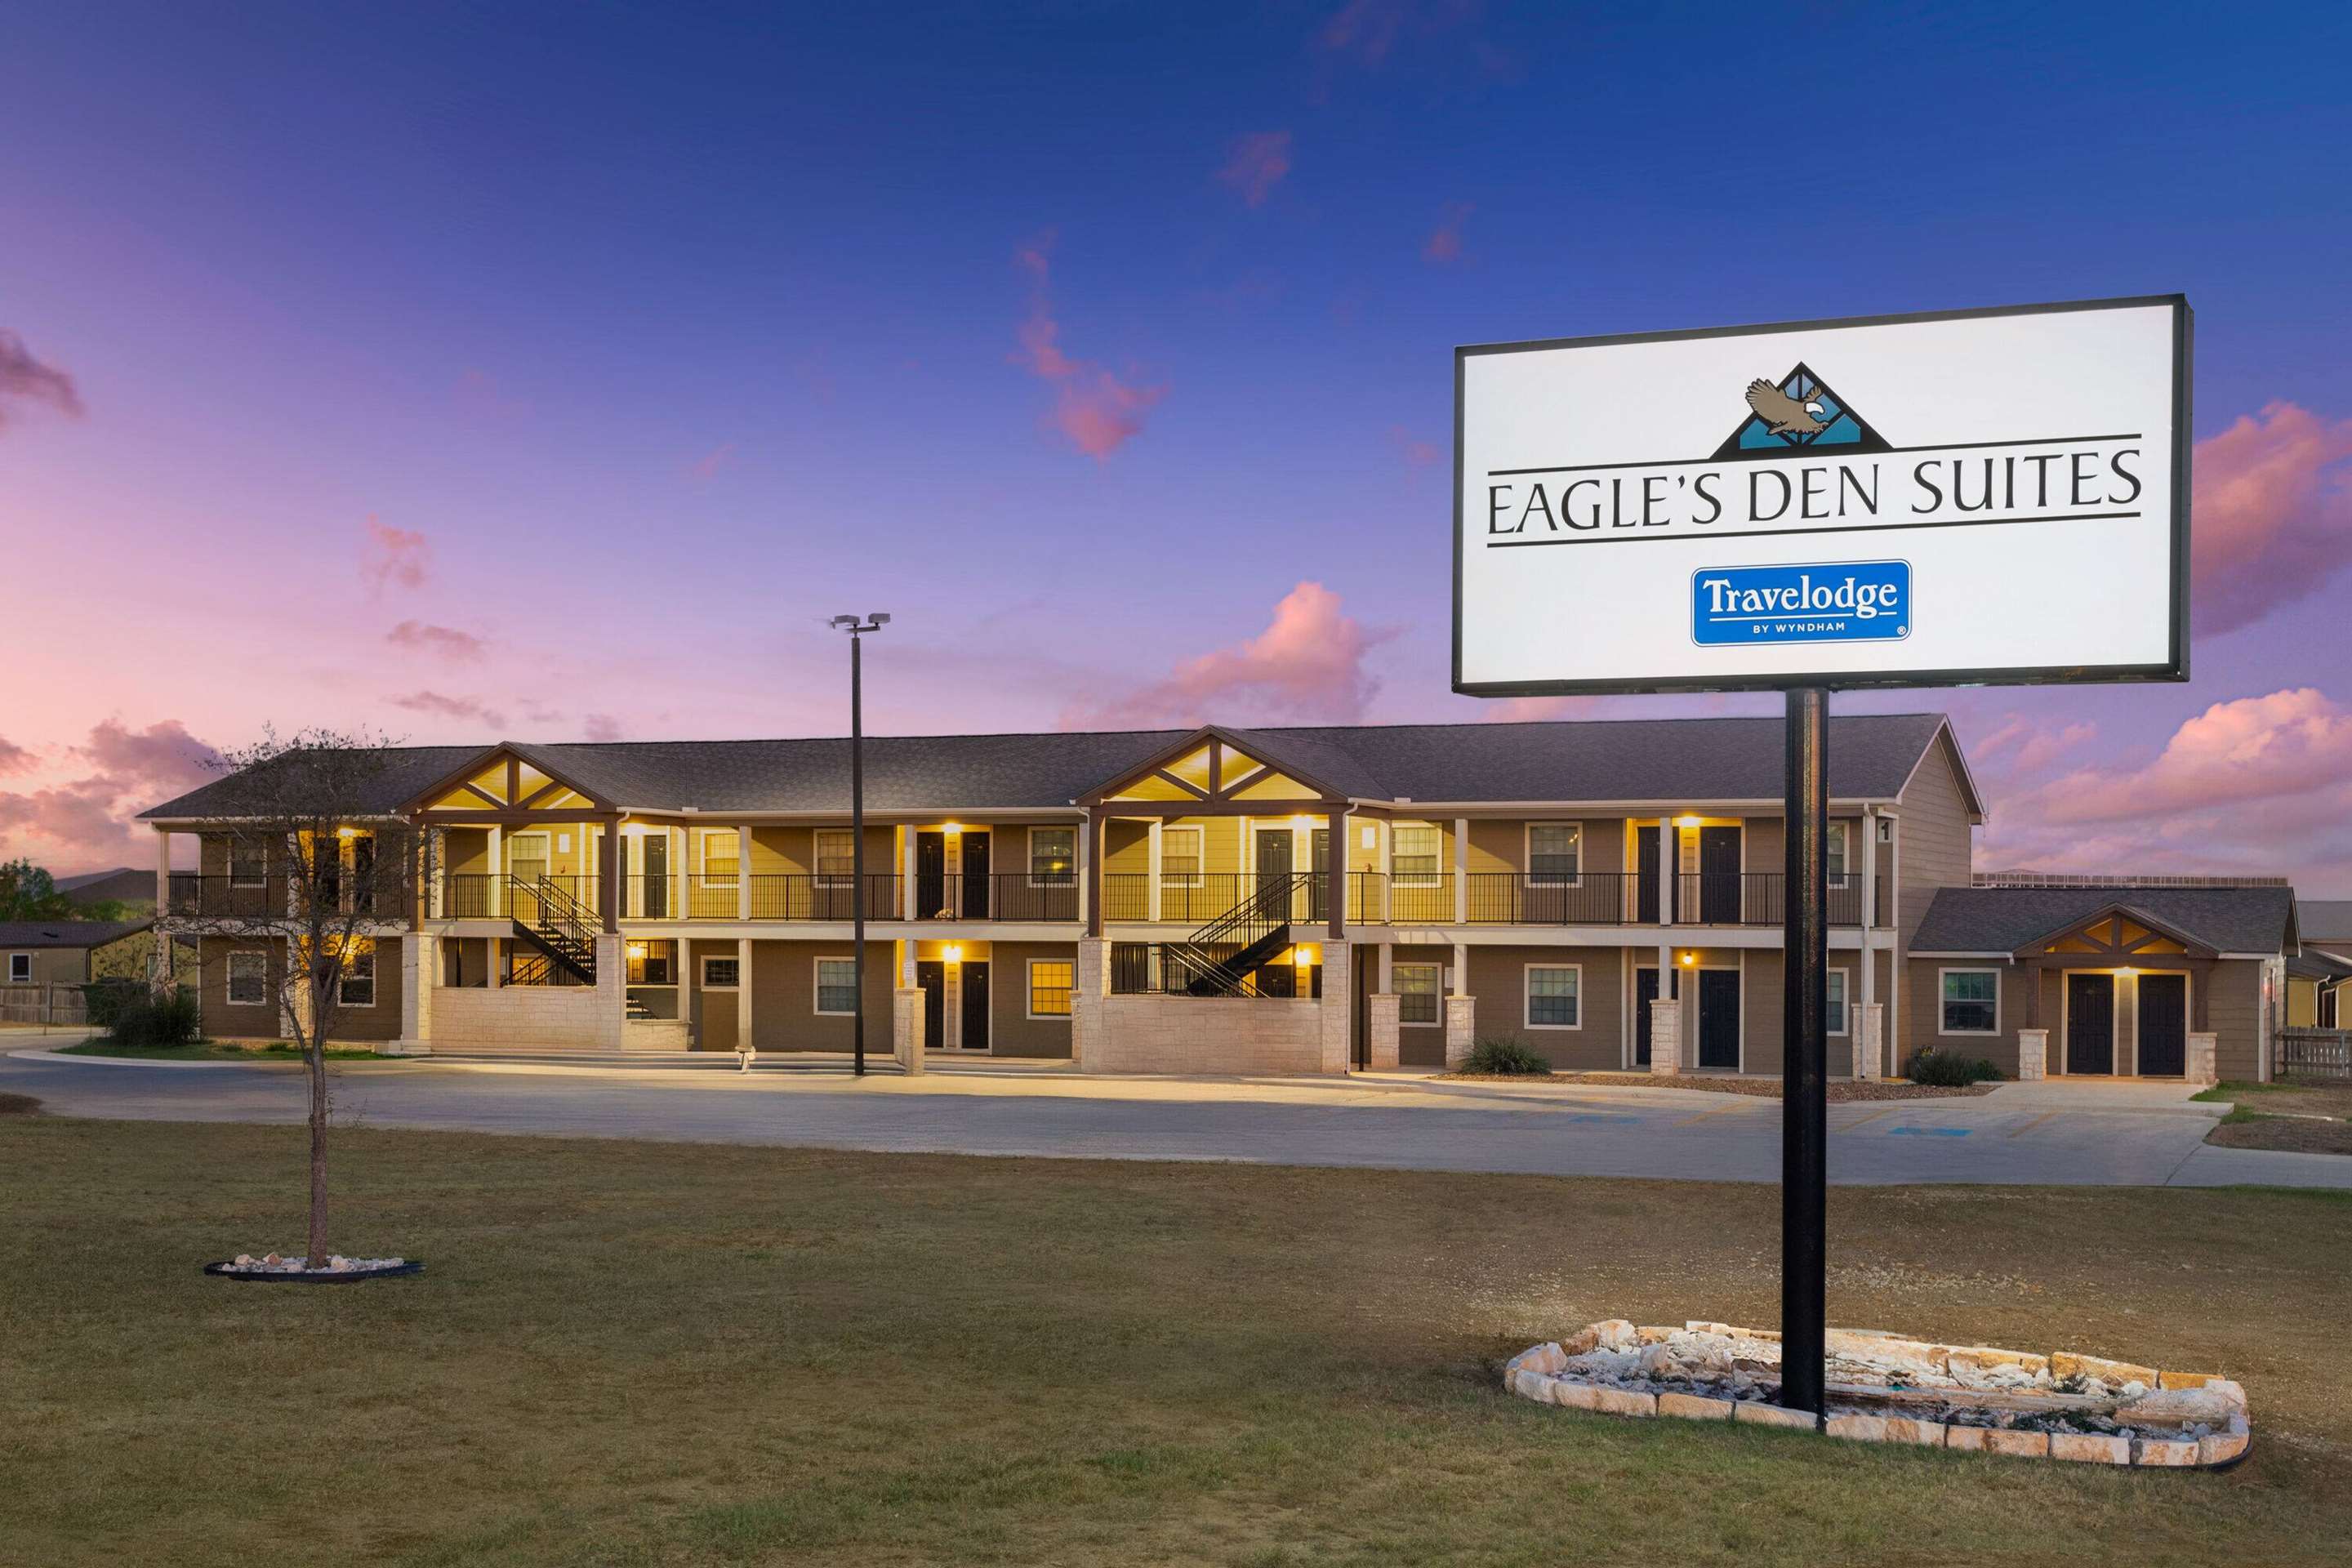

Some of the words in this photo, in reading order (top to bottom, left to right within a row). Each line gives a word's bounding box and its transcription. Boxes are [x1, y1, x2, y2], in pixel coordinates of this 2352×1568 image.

[1488, 473, 1722, 534] EAGLE'S
[1748, 464, 1879, 522] DEN
[1912, 449, 2142, 514] SUITES
[1703, 574, 1898, 619] Travelodge
[1753, 625, 1769, 634] BY
[1775, 622, 1845, 633] WYNDHAM
[1882, 822, 1889, 840] 1
